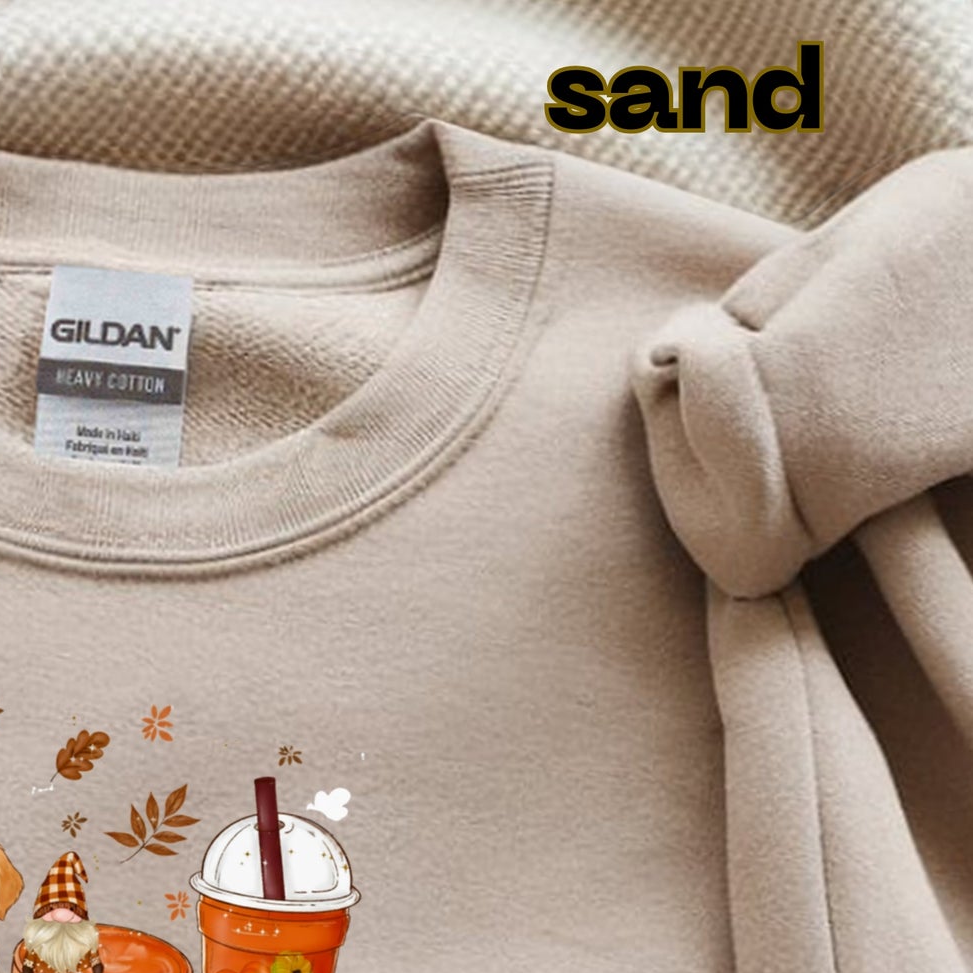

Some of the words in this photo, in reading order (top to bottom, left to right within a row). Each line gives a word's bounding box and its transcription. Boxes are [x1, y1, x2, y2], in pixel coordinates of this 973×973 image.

[51, 318, 175, 351] GILDAN
[56, 368, 103, 387] HEAVY
[107, 372, 165, 393] COTTON
